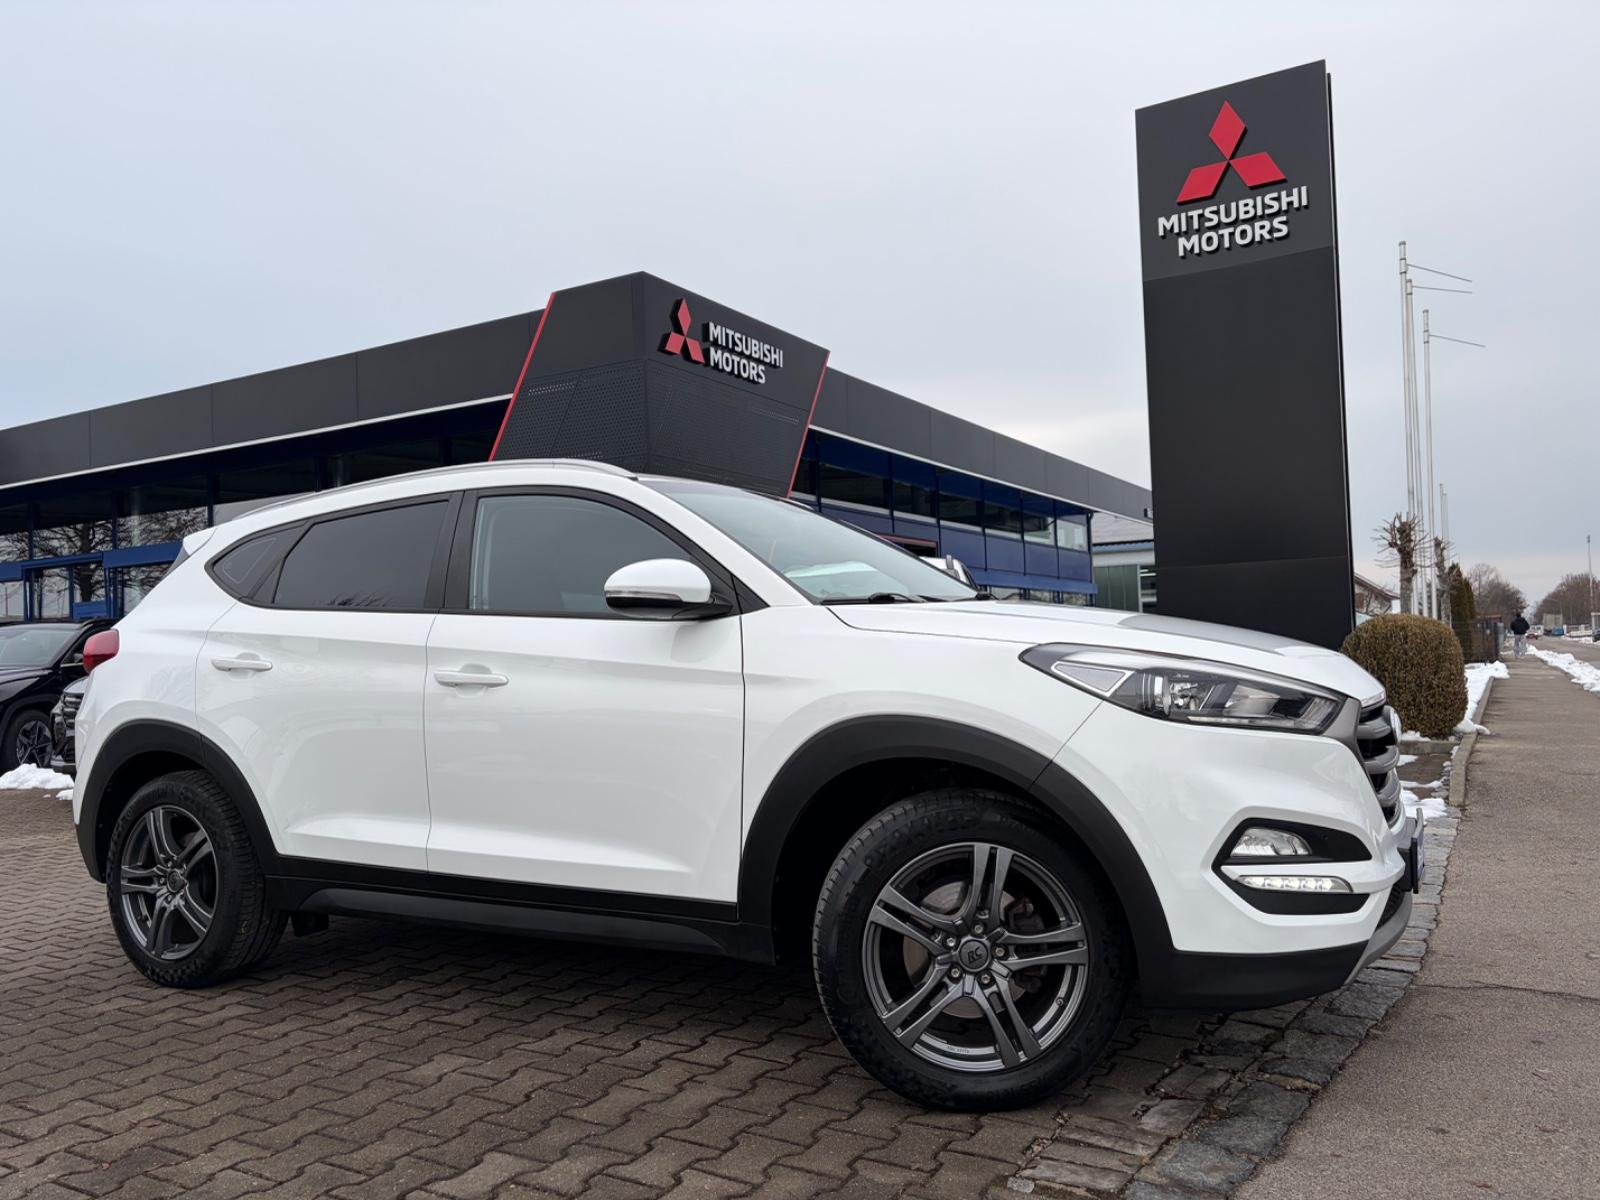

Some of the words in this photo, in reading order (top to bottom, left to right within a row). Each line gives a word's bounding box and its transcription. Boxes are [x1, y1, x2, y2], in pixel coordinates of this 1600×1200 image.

[1157, 185, 1308, 236] MITSUBISHI
[1178, 216, 1289, 257] MOTORS
[708, 321, 783, 368] MITSUBISHI
[709, 347, 766, 384] MOTORS
